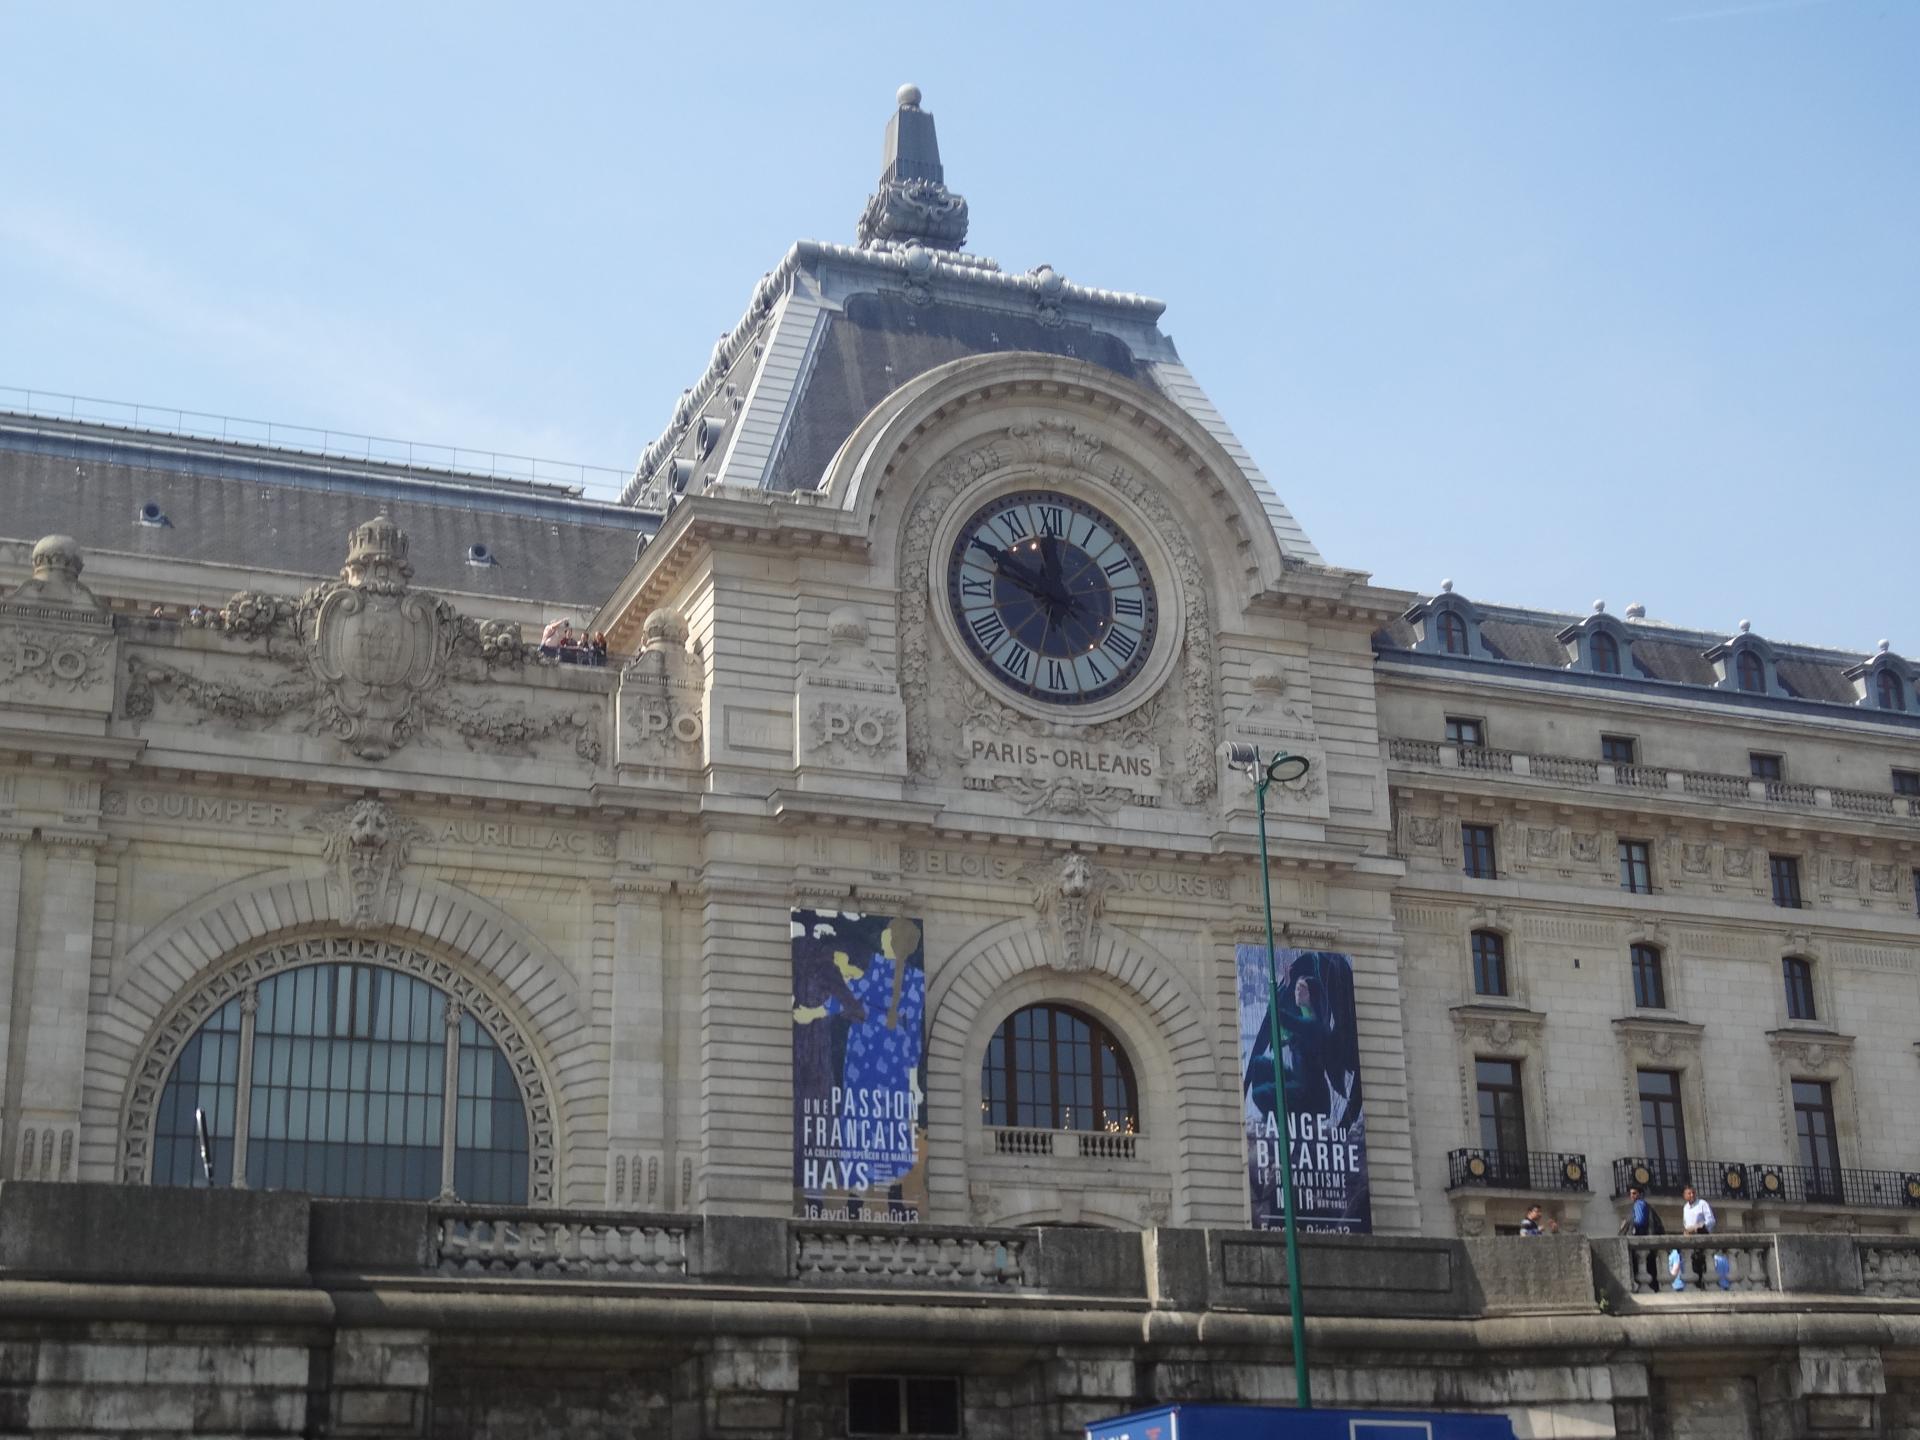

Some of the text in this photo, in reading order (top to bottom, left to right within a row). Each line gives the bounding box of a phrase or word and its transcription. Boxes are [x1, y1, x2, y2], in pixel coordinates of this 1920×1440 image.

[971, 740, 1152, 777] PARIS-ORLEANS
[135, 793, 290, 828] QUIMPER
[440, 820, 586, 854] AURILLAC
[925, 849, 1007, 880] BLOIS
[1121, 869, 1210, 897] TOURS
[803, 1086, 919, 1121] UNE PASSION
[803, 1116, 919, 1153] FRANÇAISE
[1331, 1127, 1347, 1143] DU
[803, 1159, 869, 1192] HAYS
[1258, 1169, 1346, 1189] LE RMANTISME
[804, 1205, 818, 1221] 16
[820, 1206, 849, 1222] avril
[858, 1208, 872, 1222] 18
[1276, 1187, 1314, 1211] NIR
